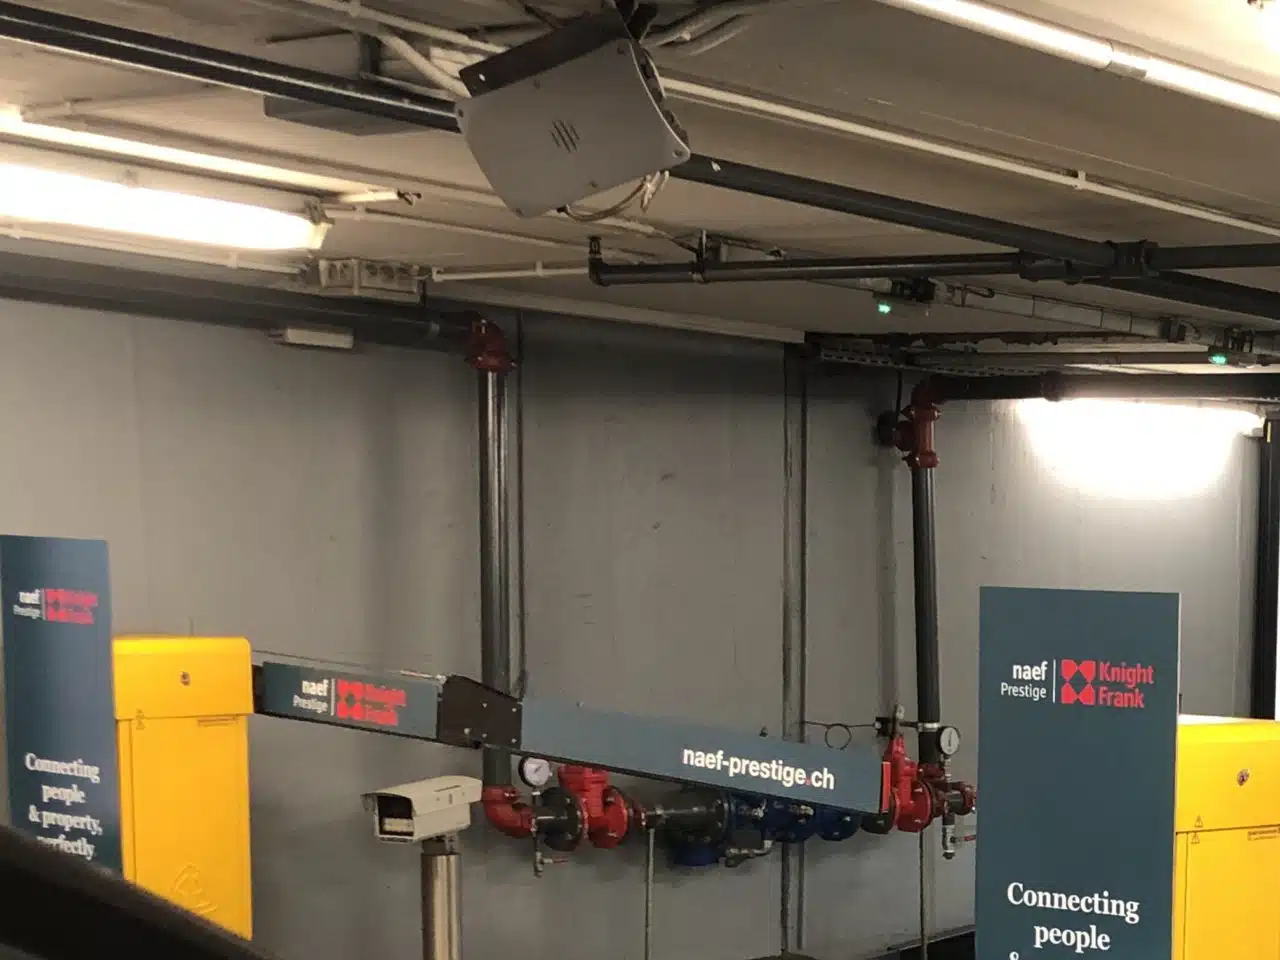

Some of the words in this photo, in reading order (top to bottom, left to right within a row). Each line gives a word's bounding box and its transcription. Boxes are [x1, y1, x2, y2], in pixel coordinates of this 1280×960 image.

[1012, 660, 1048, 681] naef
[1099, 660, 1154, 688] Knight
[1000, 682, 1047, 701] Prestige
[1099, 686, 1145, 708] Frank
[24, 752, 101, 784] Connecting
[682, 748, 835, 790] naef-prestige.ch
[41, 784, 86, 806] people
[41, 810, 103, 836] property,
[1007, 881, 1140, 924] Connecting
[1033, 924, 1111, 953] people
